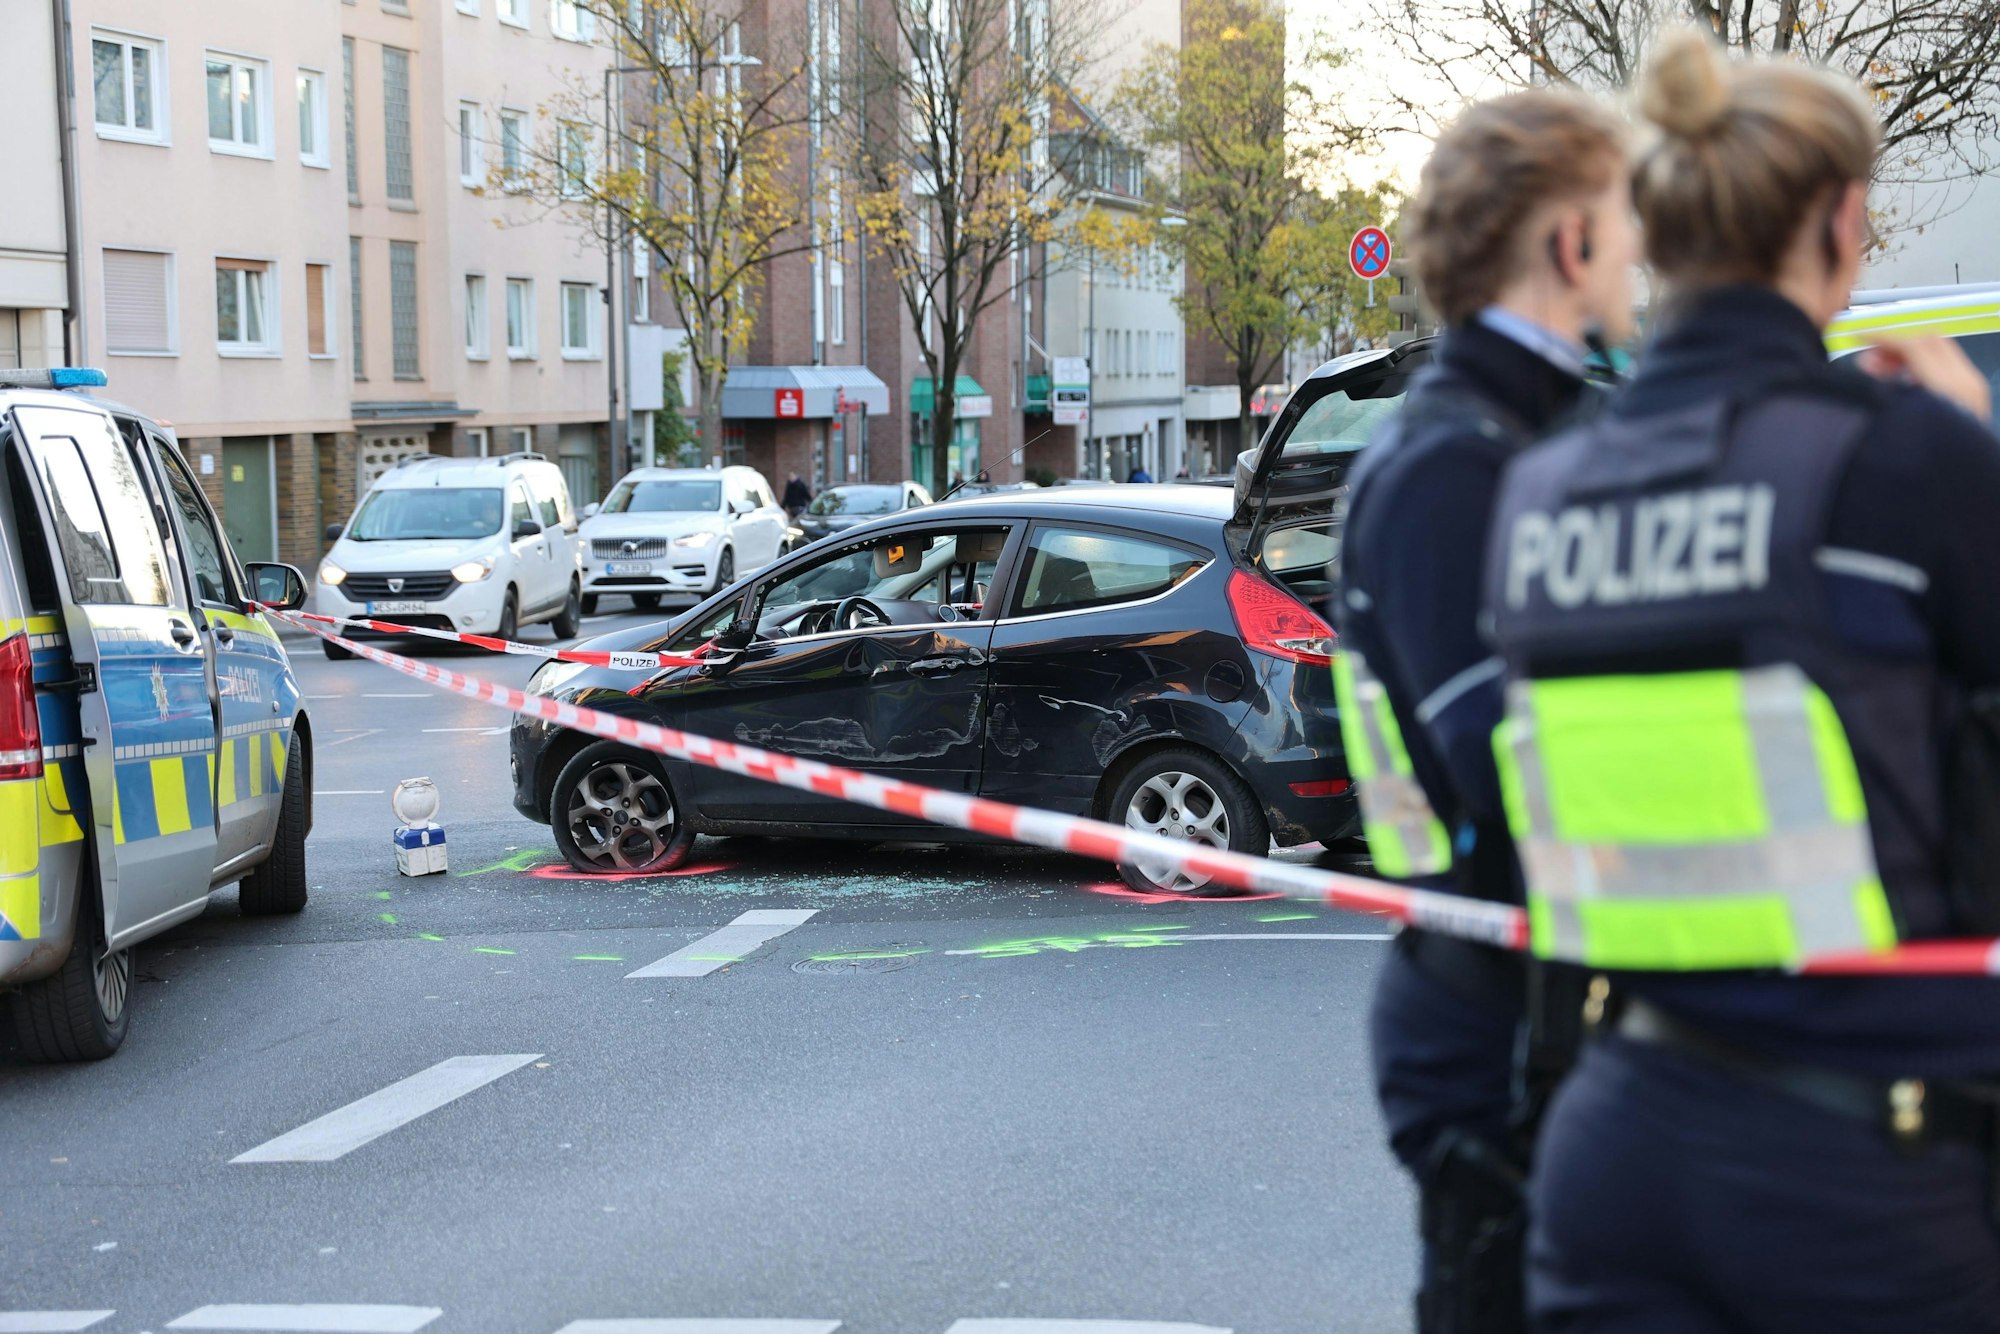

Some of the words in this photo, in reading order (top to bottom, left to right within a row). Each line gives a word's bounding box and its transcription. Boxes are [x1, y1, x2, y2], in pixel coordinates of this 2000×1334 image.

[1505, 483, 1774, 610] POLIZEI
[612, 656, 656, 667] POLIZEI
[227, 665, 262, 703] POLIZEI
